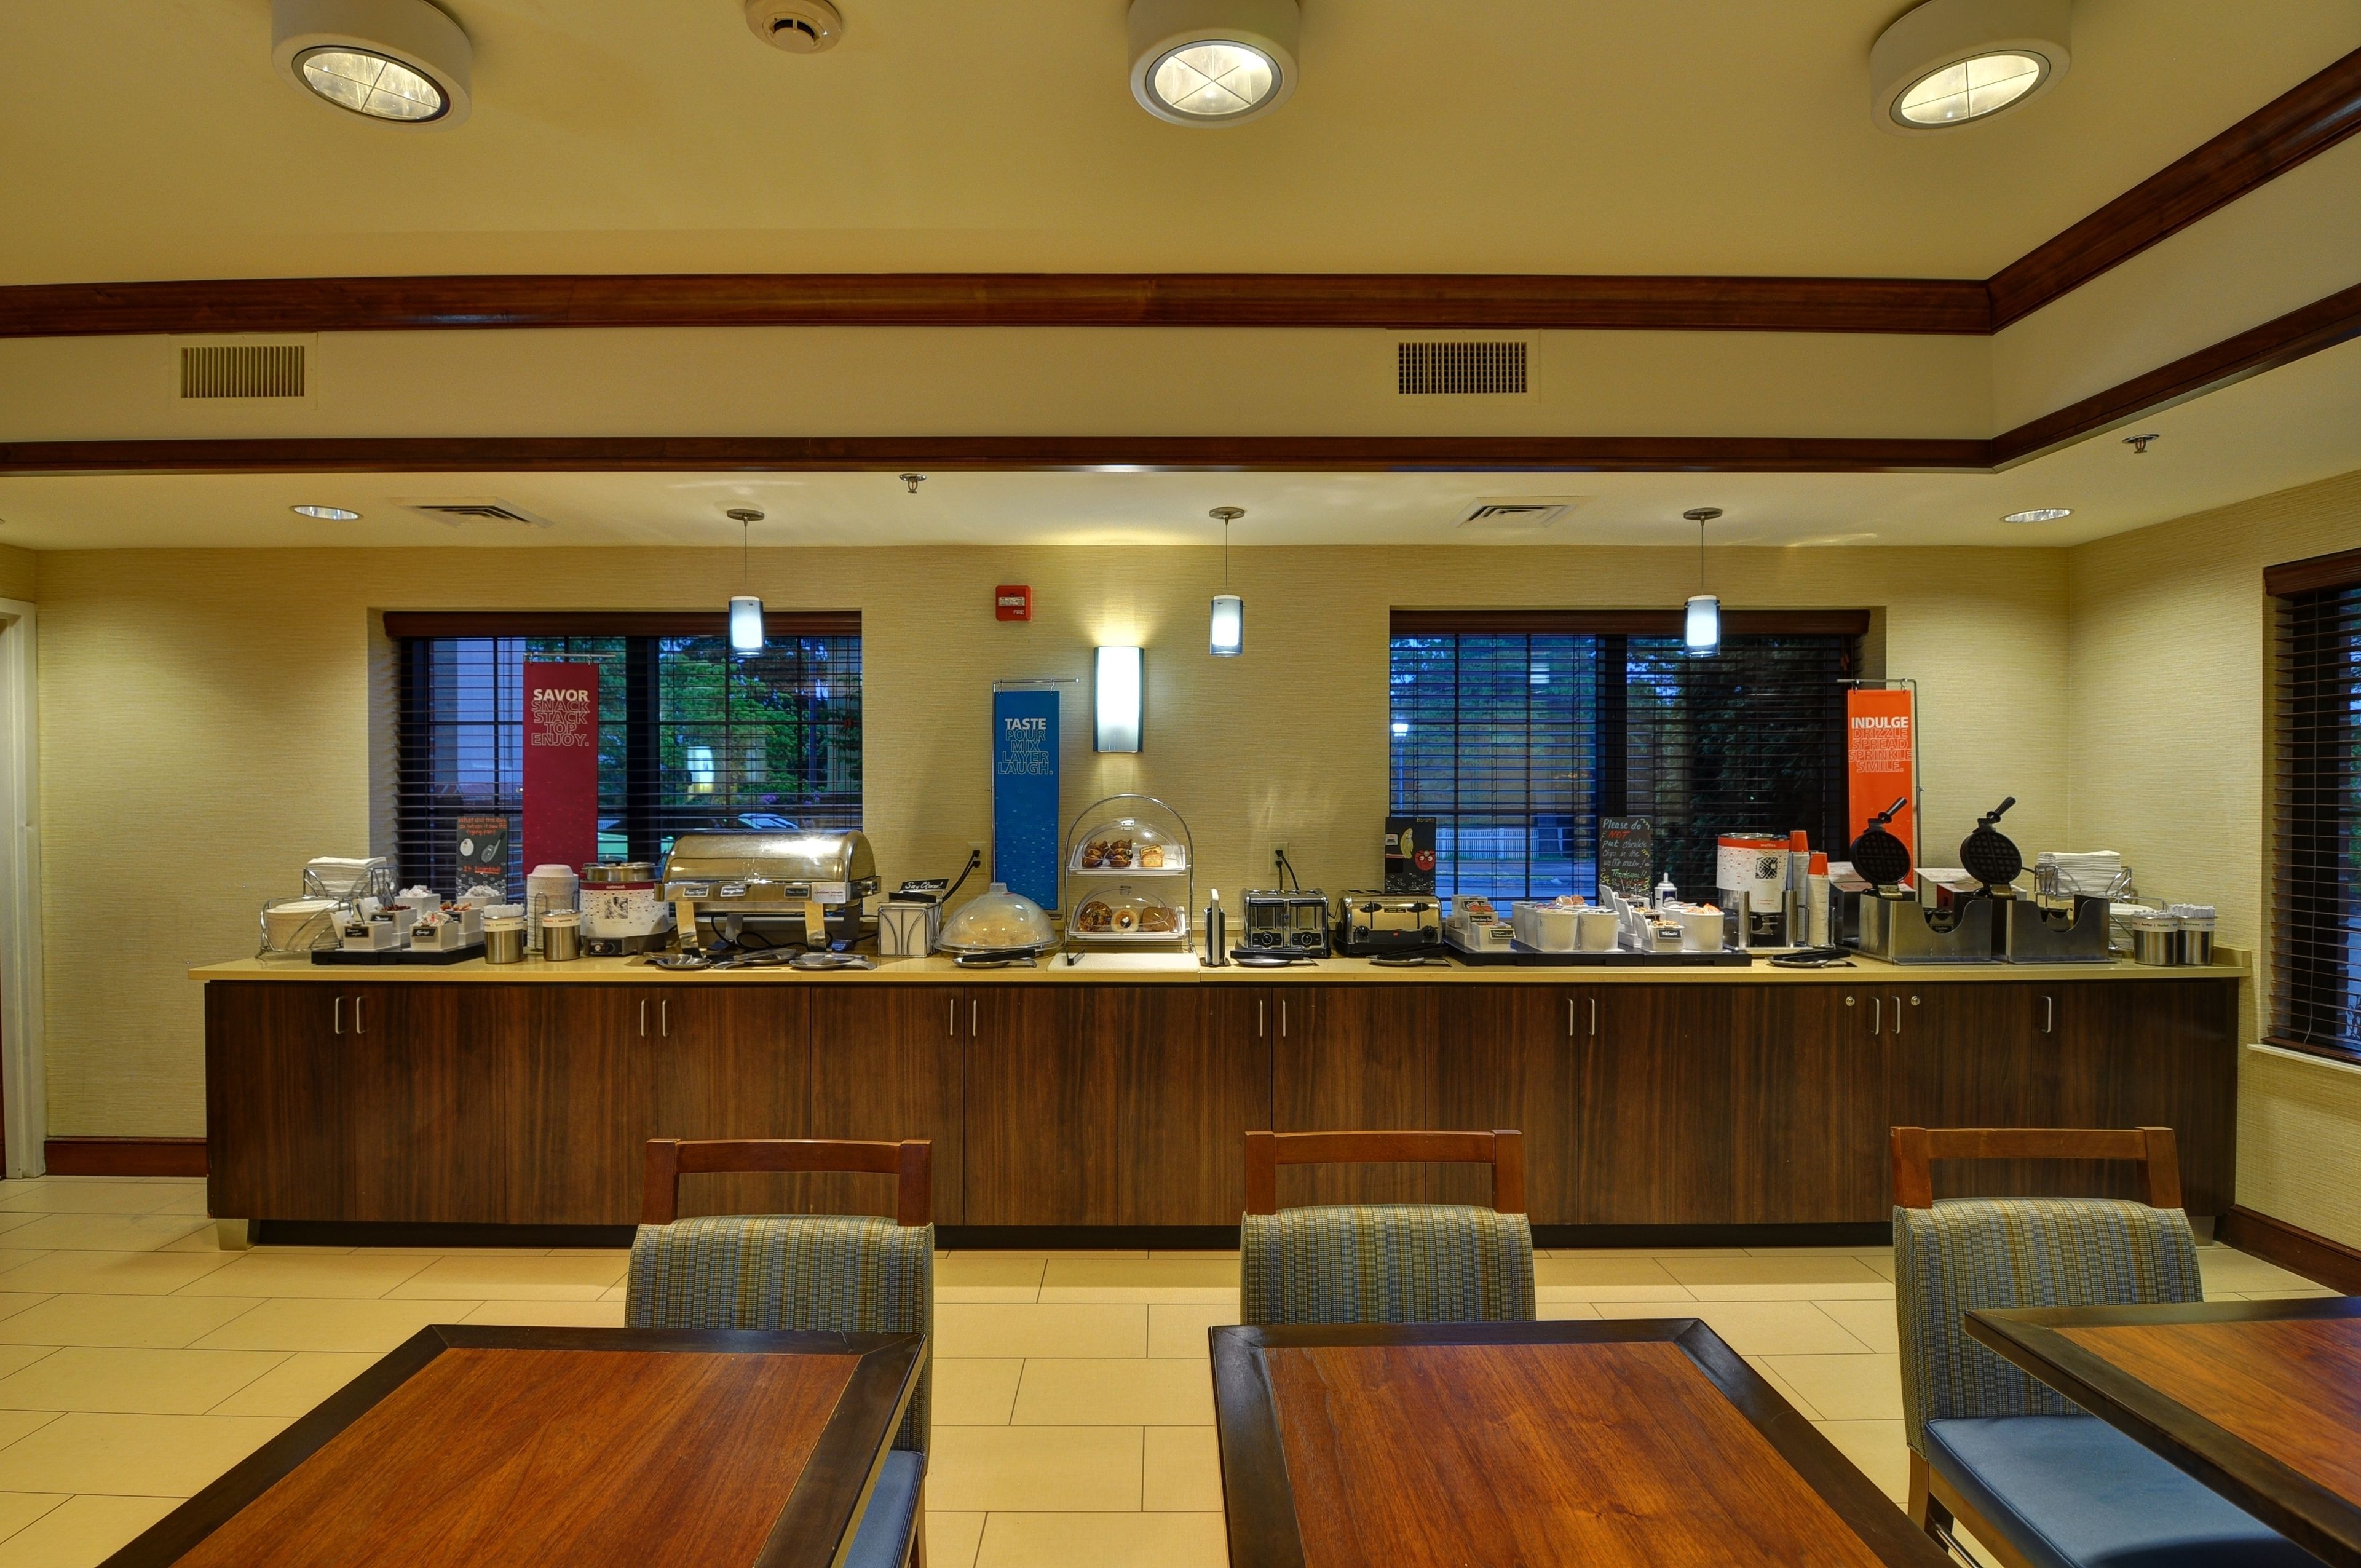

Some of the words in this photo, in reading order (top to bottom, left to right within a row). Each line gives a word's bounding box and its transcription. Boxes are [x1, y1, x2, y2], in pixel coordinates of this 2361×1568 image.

[533, 689, 589, 702] SAVOR
[531, 700, 590, 713] SNACK
[534, 711, 588, 724] STACK
[1851, 716, 1908, 729] INDULGE
[544, 722, 577, 735] TOP
[1005, 718, 1046, 730] TASTE
[1006, 729, 1046, 741] POUR
[1853, 727, 1908, 739] DRIZZLE
[531, 733, 589, 746] ENJOY.
[1853, 738, 1908, 750] SPREAD
[1011, 740, 1040, 752] MIX
[1003, 751, 1049, 763] LAYER
[1849, 749, 1912, 762] SPRINKLE
[998, 762, 1053, 775] LAUGH.
[1856, 760, 1904, 773] SMILE.
[1603, 818, 1628, 829] Please
[1631, 820, 1642, 830] do
[1608, 830, 1630, 839] NOT
[1602, 839, 1619, 849] put
[905, 882, 919, 890] Say
